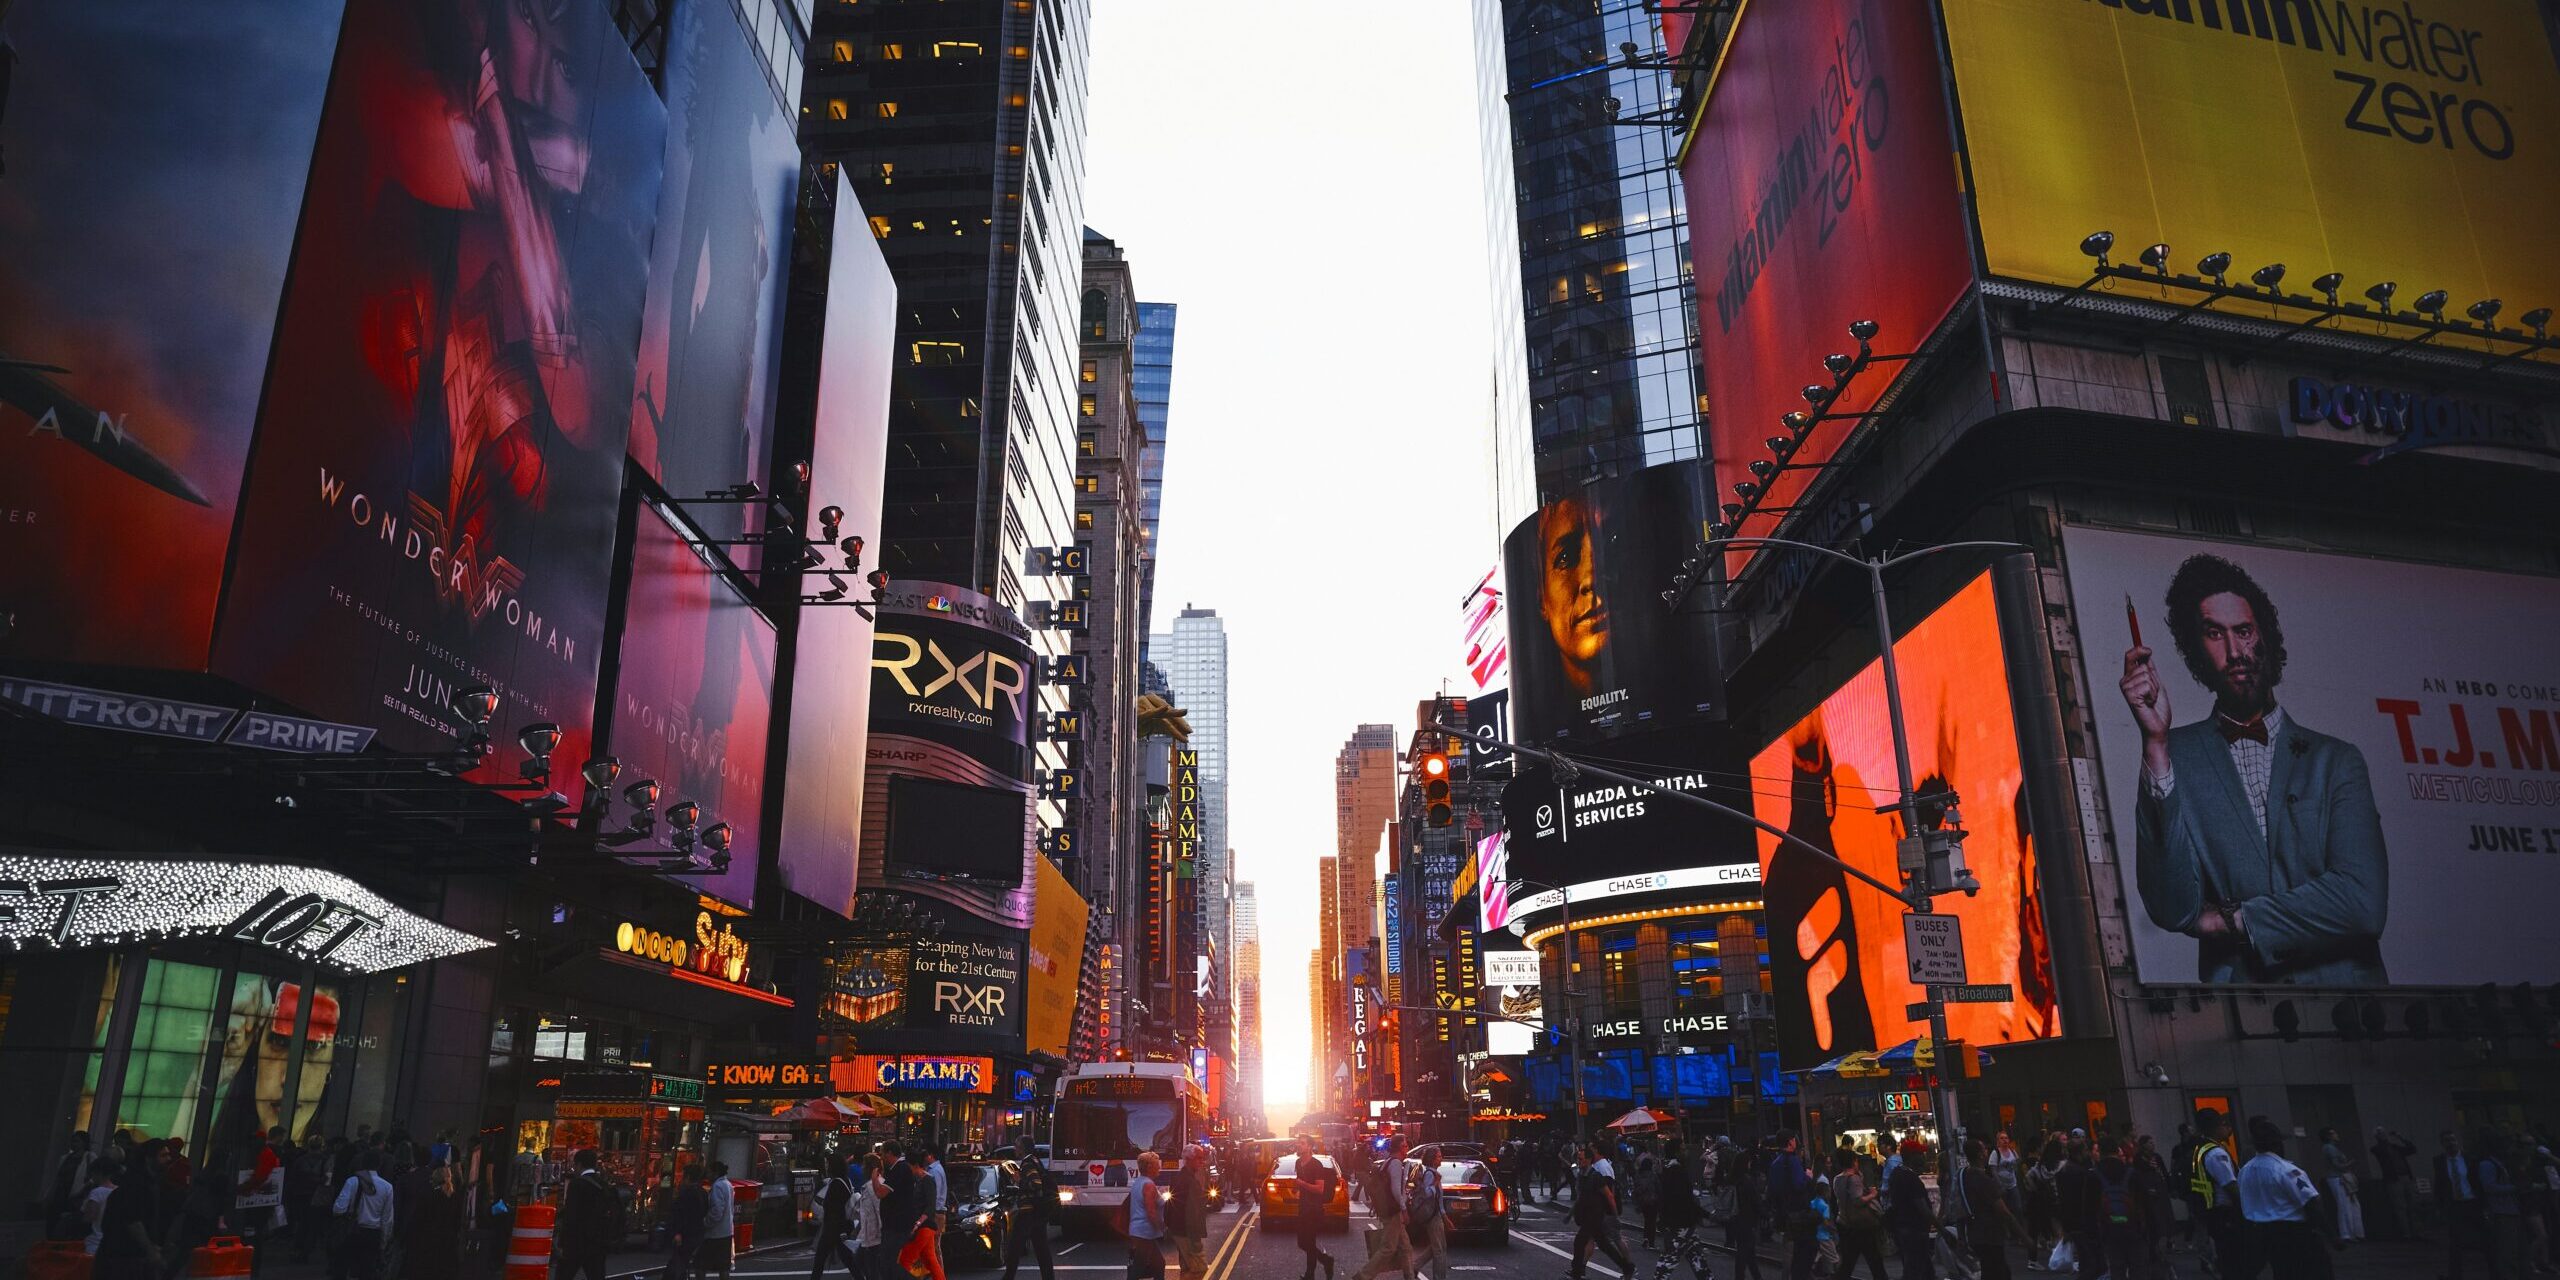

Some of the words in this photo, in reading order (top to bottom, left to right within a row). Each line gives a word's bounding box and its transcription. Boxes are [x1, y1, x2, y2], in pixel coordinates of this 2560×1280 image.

[2333, 69, 2515, 161] zero
[1812, 75, 1889, 250] zero
[320, 466, 466, 591] WONDER
[485, 580, 576, 665] WOMAN
[328, 584, 352, 608] THE
[358, 602, 401, 635] FUTURE
[406, 629, 421, 645] OF
[425, 641, 466, 672] JUSTICE
[471, 666, 505, 692] BEGINS
[403, 663, 452, 710] JUN
[872, 632, 1024, 723] RXR
[2423, 677, 2447, 693] AN
[2455, 679, 2498, 697] HBO
[1058, 551, 1081, 852] CHAMPS
[1581, 688, 1629, 711] EQUALITY.
[908, 701, 993, 727] rxrrealty.com
[246, 719, 360, 753] PRIME
[626, 693, 700, 760] WONDER
[708, 748, 758, 796] WOMAN
[2376, 698, 2497, 769] T.J.
[866, 749, 928, 762] SHARP
[1178, 750, 1197, 858] MADAME
[1573, 785, 1627, 809] MAZDA
[1574, 801, 1646, 829] SERVICES
[2468, 824, 2538, 853] JUNE
[1607, 876, 1653, 892] CHASE
[1535, 890, 1563, 907] CHASE
[229, 887, 384, 959] LOFT
[1914, 919, 1950, 933] BUSES
[971, 942, 996, 958] New
[996, 946, 1016, 962] York
[1387, 931, 1402, 974] STUDIOS
[1920, 934, 1947, 948] ONLY
[914, 957, 937, 973] for
[938, 959, 959, 974] the
[960, 961, 983, 977] 21st
[983, 964, 1018, 984] Century
[1460, 928, 1473, 992] VICTORY
[1492, 963, 1538, 974] WORK
[744, 967, 751, 983] 7
[1924, 970, 1940, 978] MON
[1952, 970, 1963, 979] FRI
[934, 981, 1006, 1017] RXR
[1958, 986, 2010, 1001] Broadway
[949, 1013, 995, 1026] REALTY
[1463, 995, 1477, 1025] NW
[1353, 986, 1368, 1070] REGAL
[1437, 1015, 1449, 1041] NEW
[1592, 1020, 1641, 1039] CHASE
[1664, 1015, 1729, 1034] CHASE
[1457, 1050, 1489, 1063] SKCHERS
[723, 1064, 776, 1085] KNOW
[877, 1062, 981, 1088] CHAMPS
[557, 1104, 594, 1116] HALAL
[609, 1105, 642, 1116] FOOD
[1886, 1093, 1919, 1111] SODA
